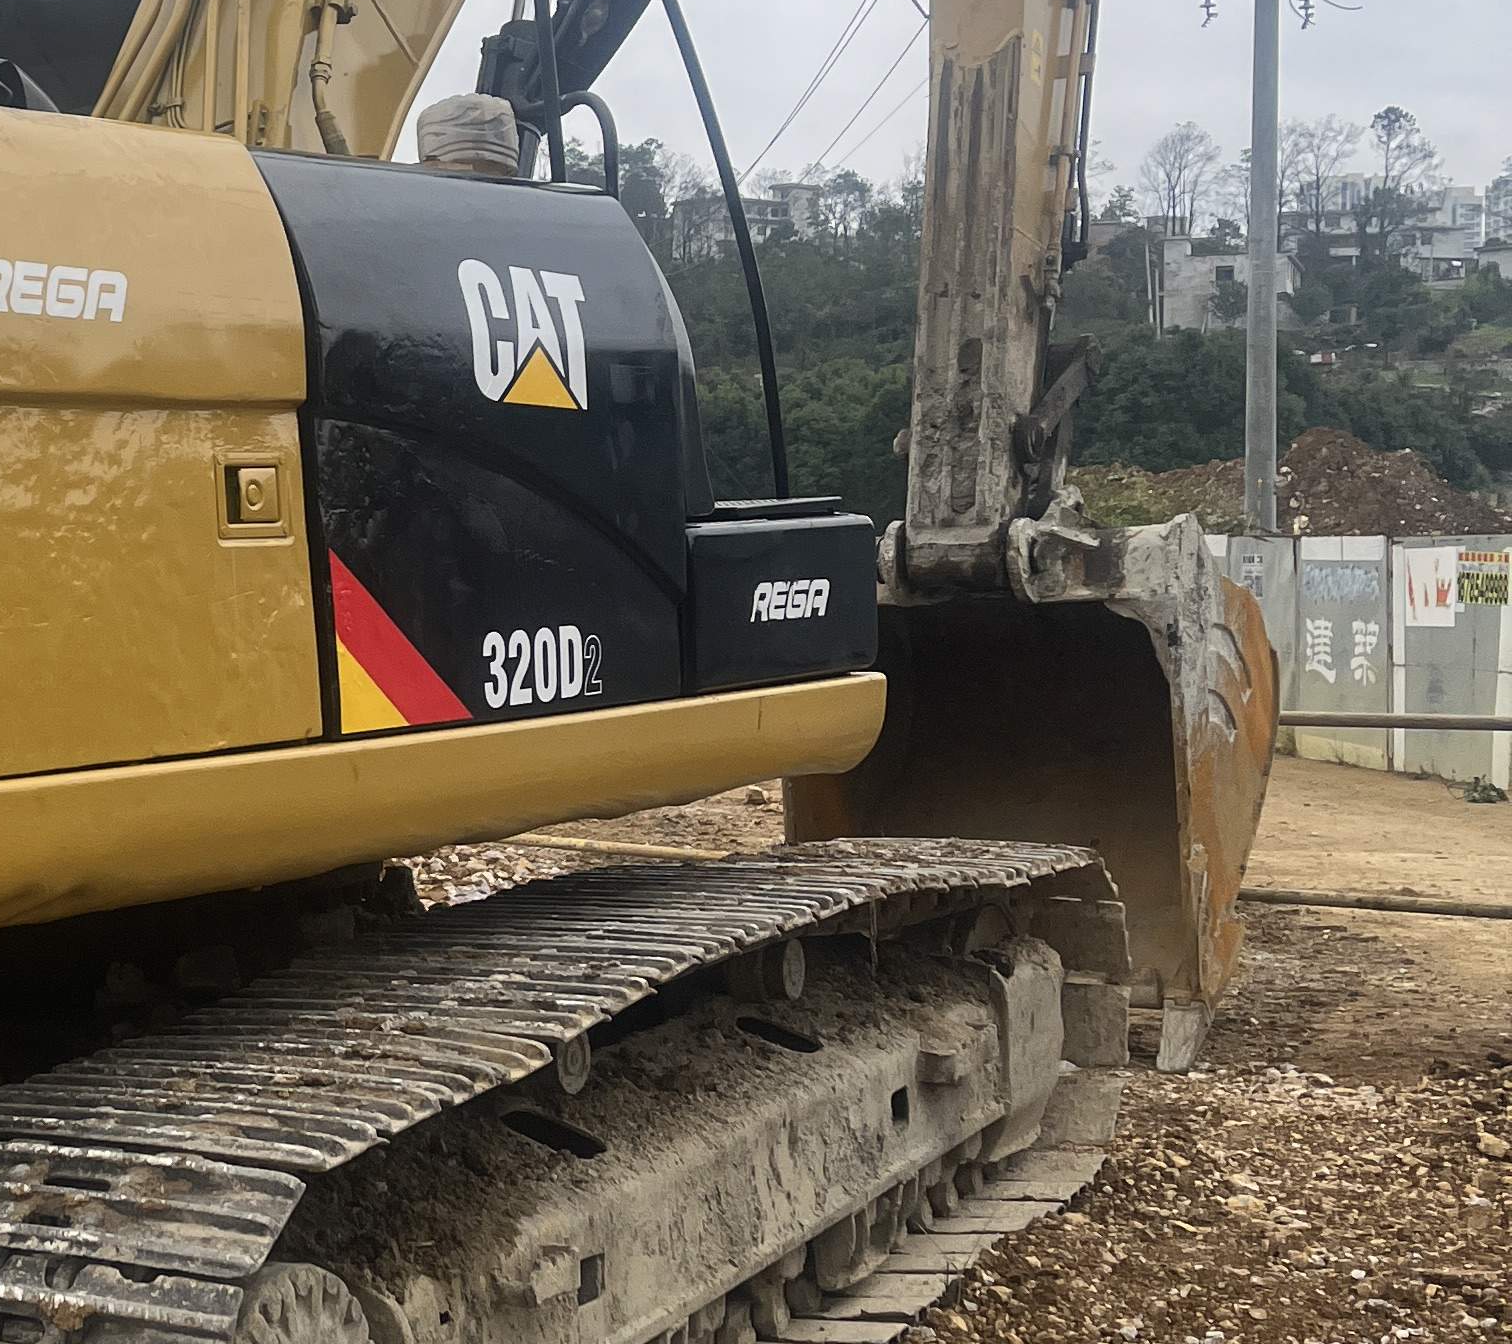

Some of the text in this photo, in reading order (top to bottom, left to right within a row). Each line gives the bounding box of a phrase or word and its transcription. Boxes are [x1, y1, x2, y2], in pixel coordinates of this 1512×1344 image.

[457, 258, 588, 410] CAT
[750, 578, 830, 623] REGA
[482, 625, 602, 709] 320D2
